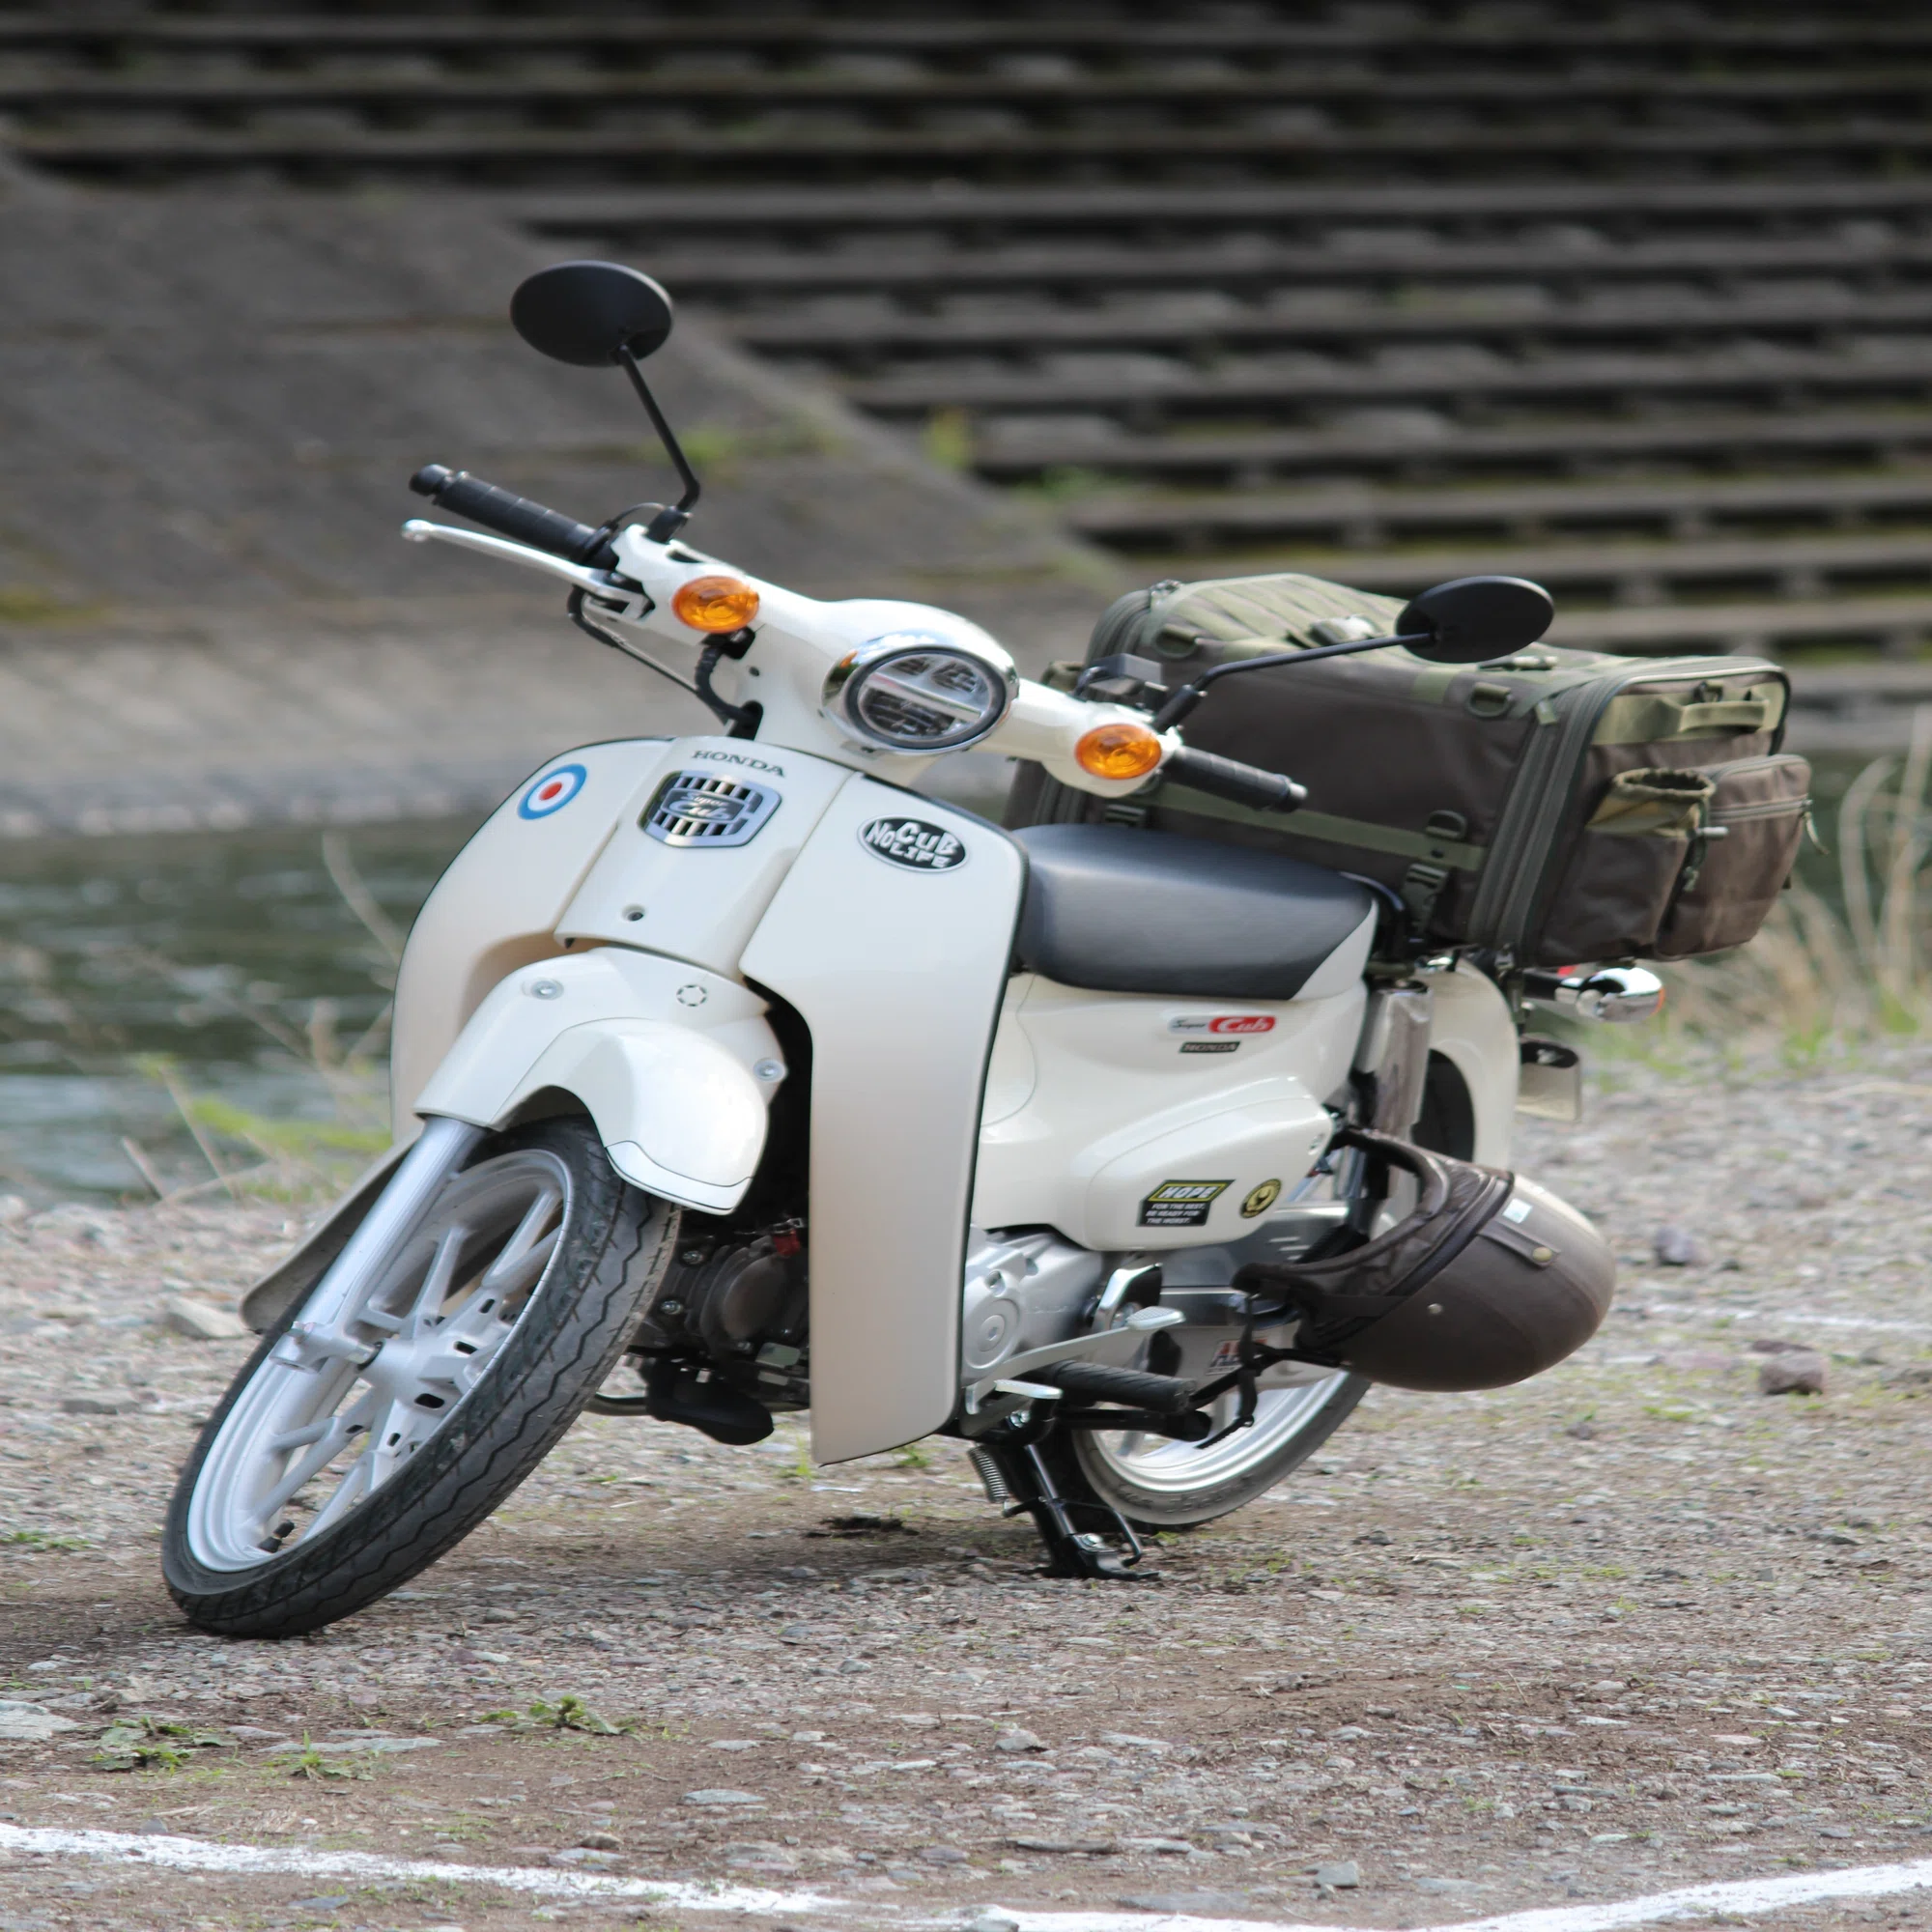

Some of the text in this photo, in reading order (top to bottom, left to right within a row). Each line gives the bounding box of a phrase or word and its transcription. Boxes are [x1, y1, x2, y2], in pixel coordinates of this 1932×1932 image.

[691, 751, 785, 778] HONDA
[680, 792, 727, 808] Super
[668, 800, 732, 820] Cub
[889, 841, 952, 868] LIFE
[1172, 1017, 1267, 1033] Super Cub
[1185, 1042, 1236, 1052] HONDA
[1158, 1187, 1218, 1199] HOPE
